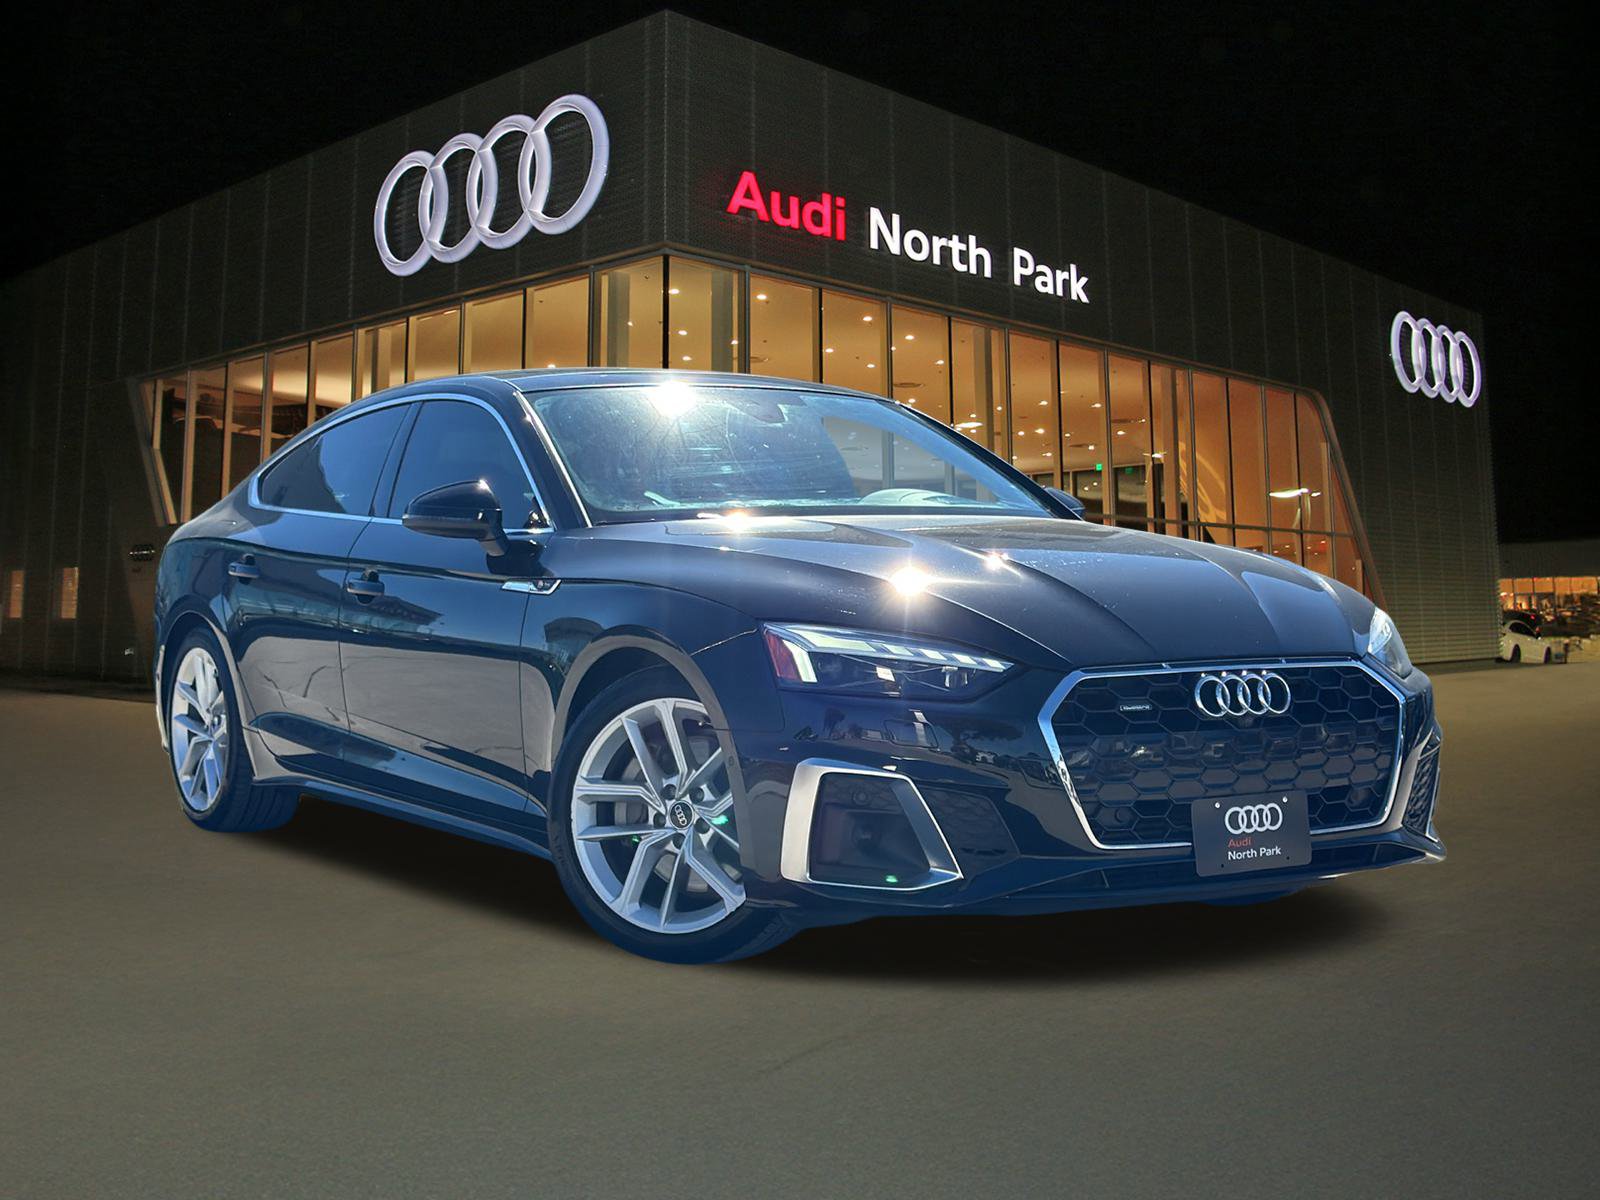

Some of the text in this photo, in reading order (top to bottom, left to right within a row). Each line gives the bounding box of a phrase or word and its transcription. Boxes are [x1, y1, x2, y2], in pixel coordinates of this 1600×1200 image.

[726, 170, 1090, 303] Audi North Park
[1228, 837, 1252, 848] Audi
[1228, 846, 1281, 860] North Park
